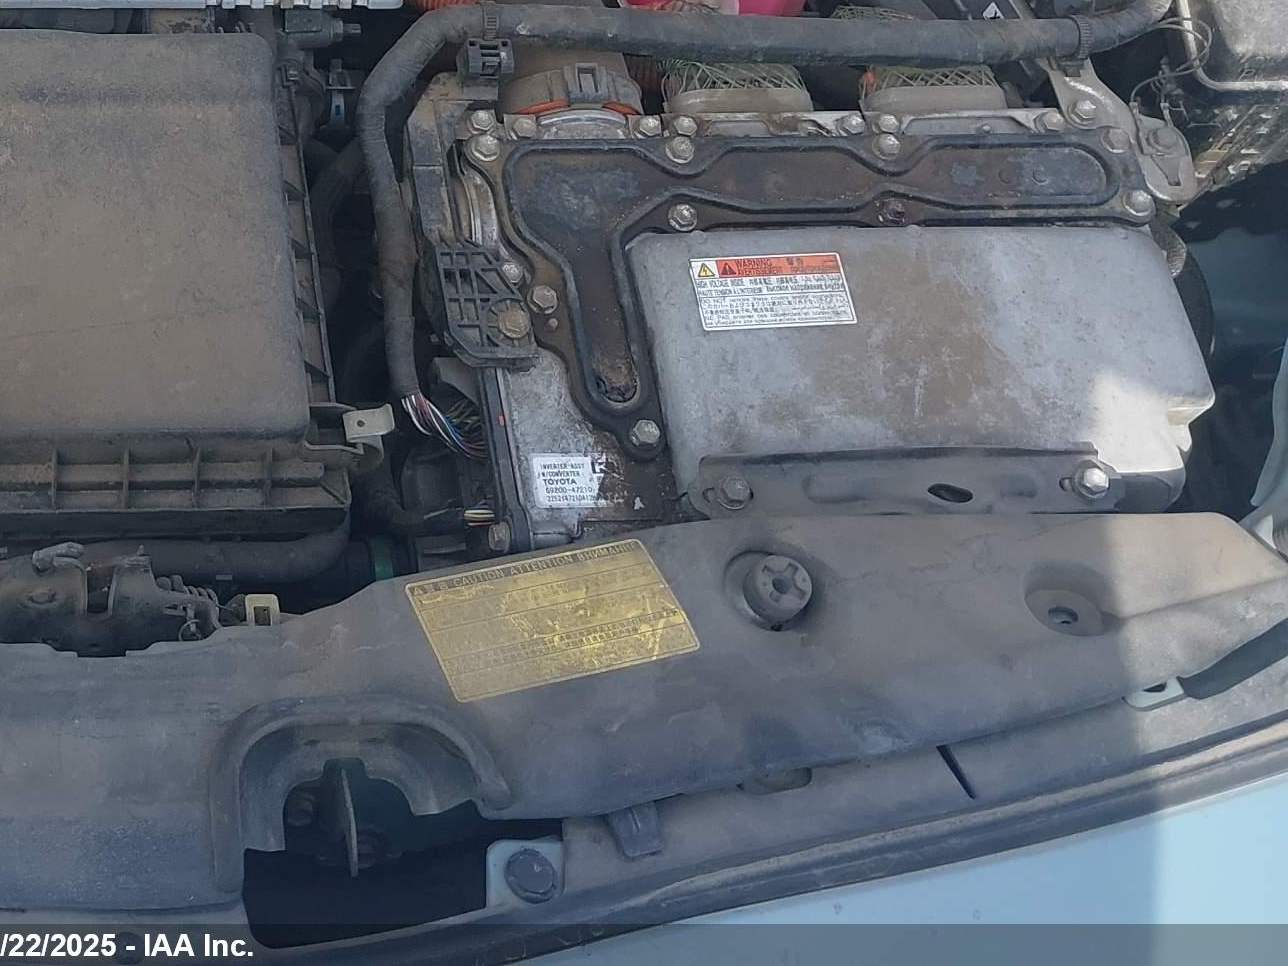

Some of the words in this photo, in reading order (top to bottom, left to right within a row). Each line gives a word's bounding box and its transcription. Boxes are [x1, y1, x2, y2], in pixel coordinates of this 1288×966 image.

[543, 478, 577, 486] TOYOTA
[455, 569, 505, 587] CAUTION
[510, 554, 573, 576] ATTENTION
